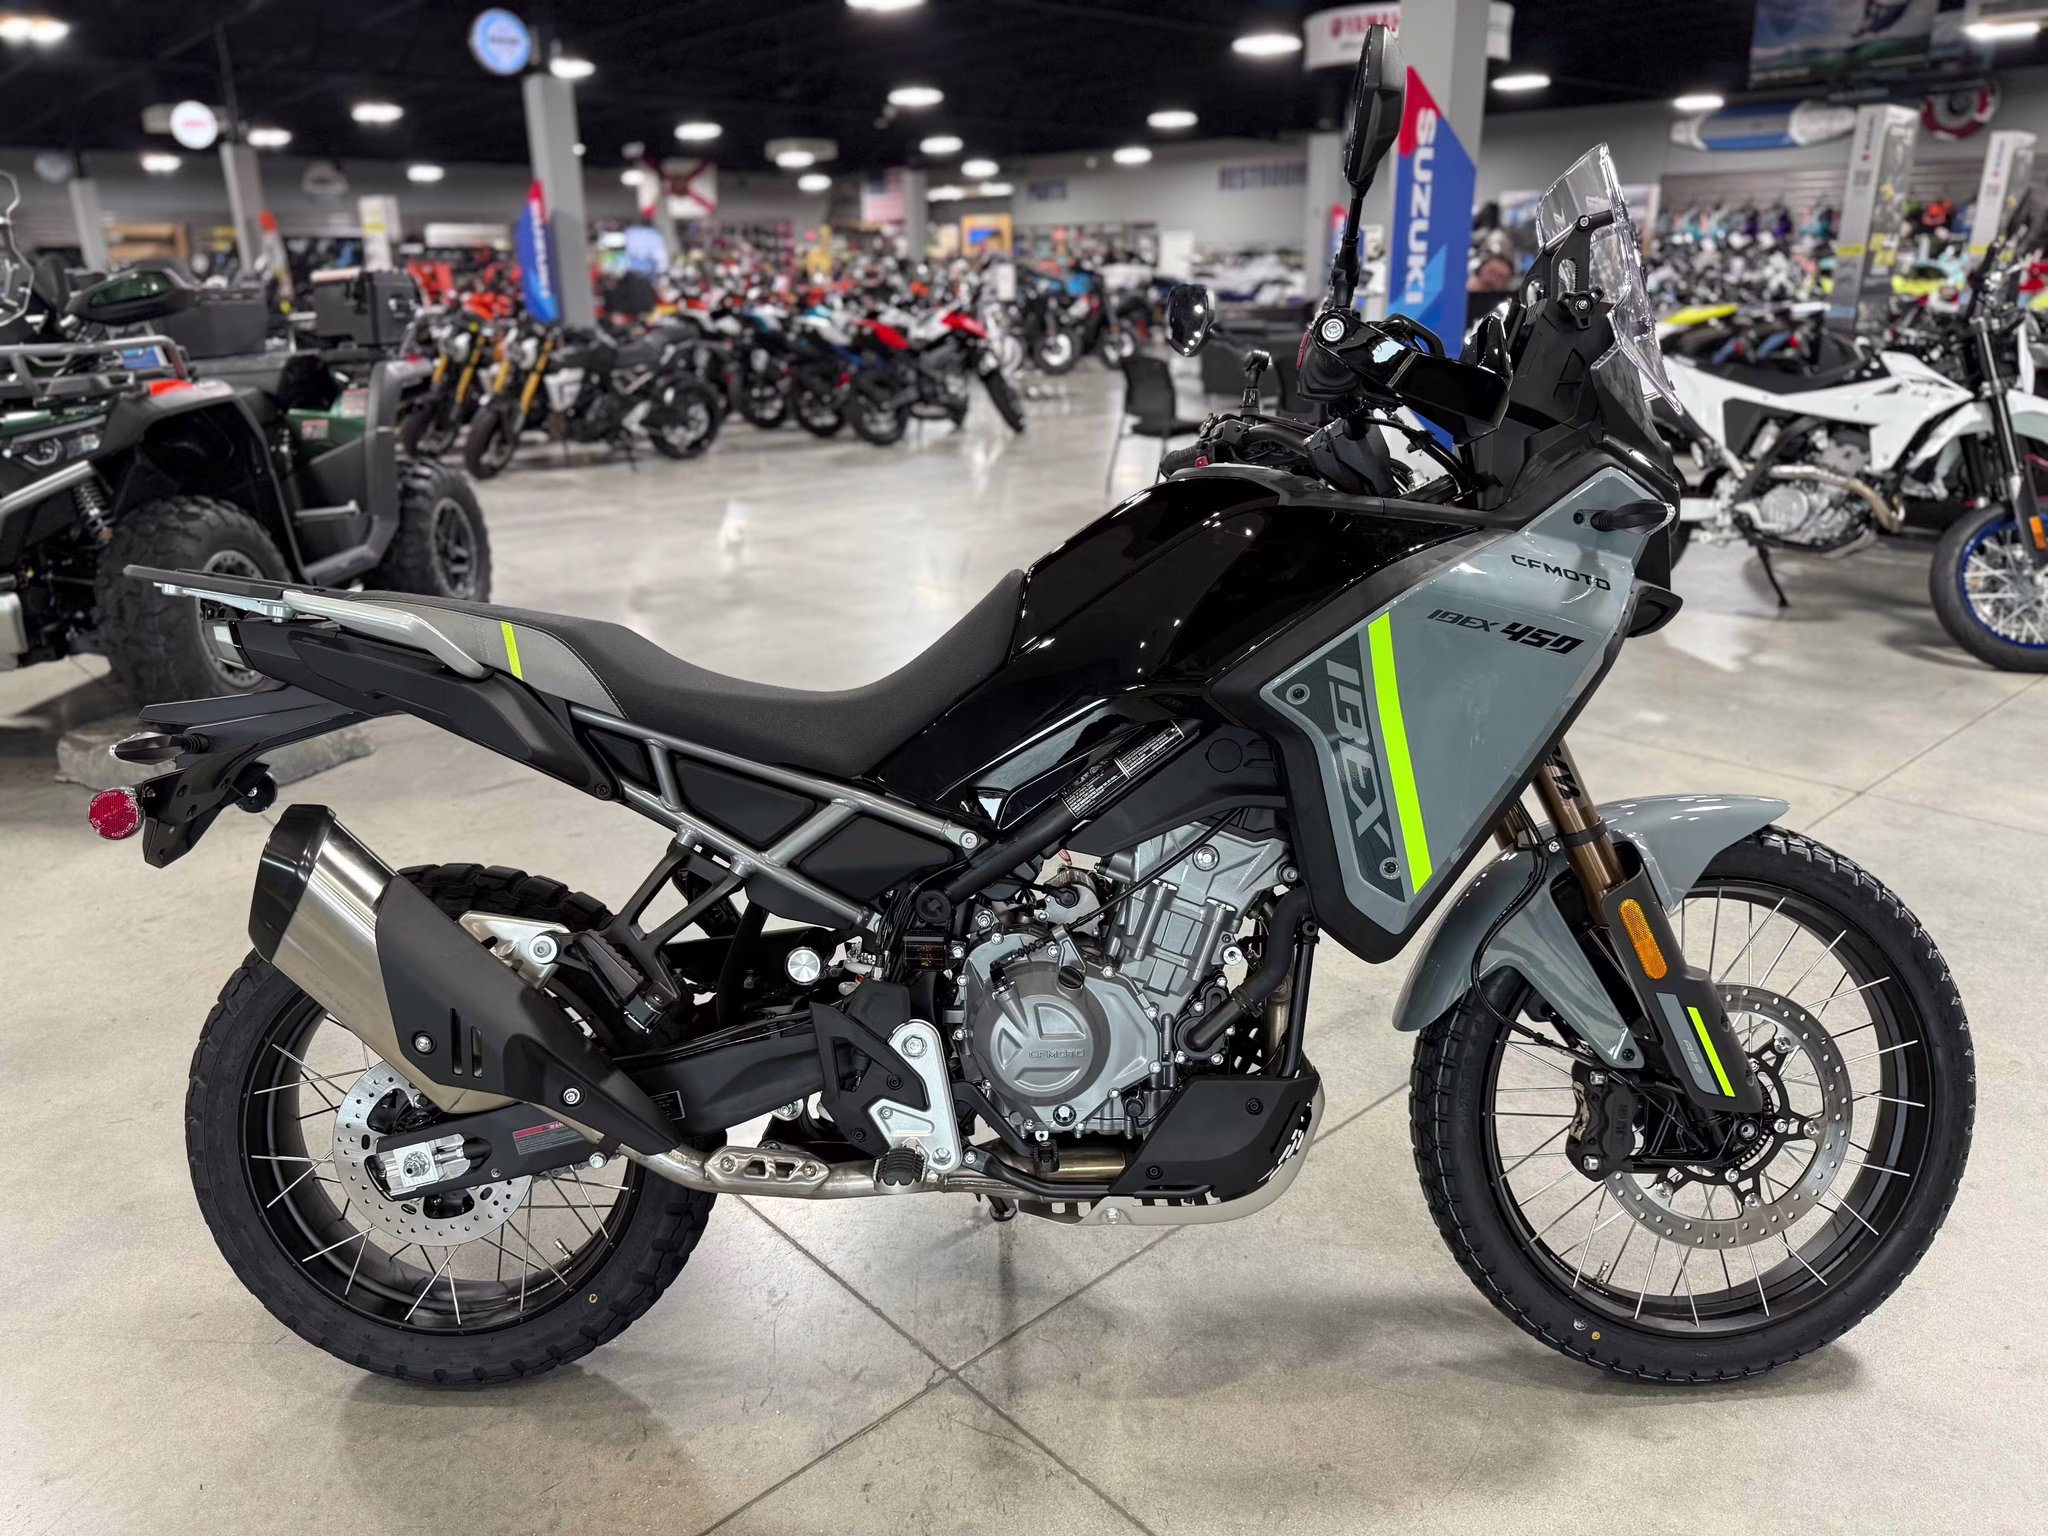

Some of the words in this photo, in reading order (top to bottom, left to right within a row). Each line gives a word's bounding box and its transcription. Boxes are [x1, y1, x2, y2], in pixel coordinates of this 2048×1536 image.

[1405, 107, 1438, 305] SUZUKI
[1510, 553, 1612, 592] CFMOTO
[1426, 608, 1501, 633] IBEX
[1500, 621, 1585, 655] 450
[1325, 658, 1392, 851] IBEX
[1028, 1048, 1086, 1059] CFMOTO
[1683, 1039, 1704, 1074] ABS
